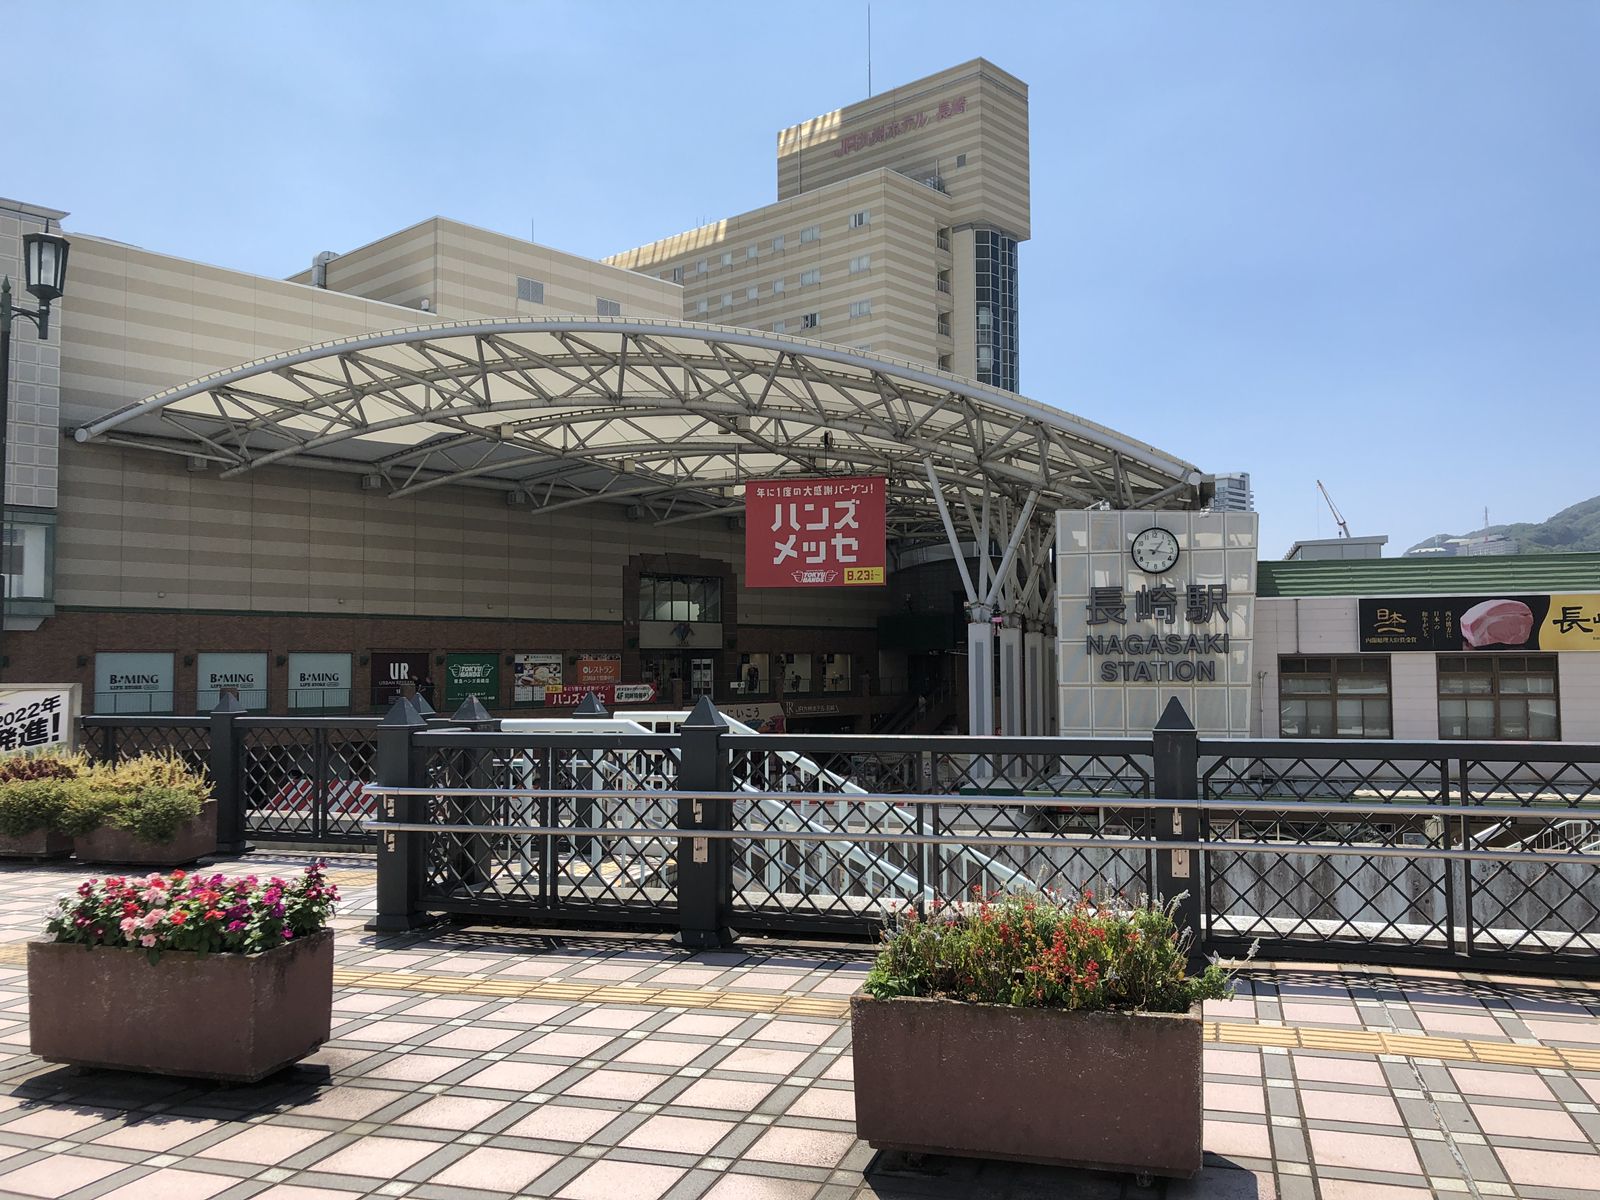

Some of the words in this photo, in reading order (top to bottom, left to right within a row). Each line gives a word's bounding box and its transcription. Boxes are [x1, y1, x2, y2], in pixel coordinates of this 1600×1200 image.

[756, 483, 875, 498] 年に1度の大感謝バーゲン!
[770, 498, 860, 532] ハンズ
[773, 532, 859, 565] メッセ
[1086, 583, 1230, 625] 長崎駅
[1086, 633, 1230, 655] NAGASAKI
[390, 662, 409, 680] UR
[1100, 660, 1216, 682] STATION
[0, 695, 61, 727] 022年
